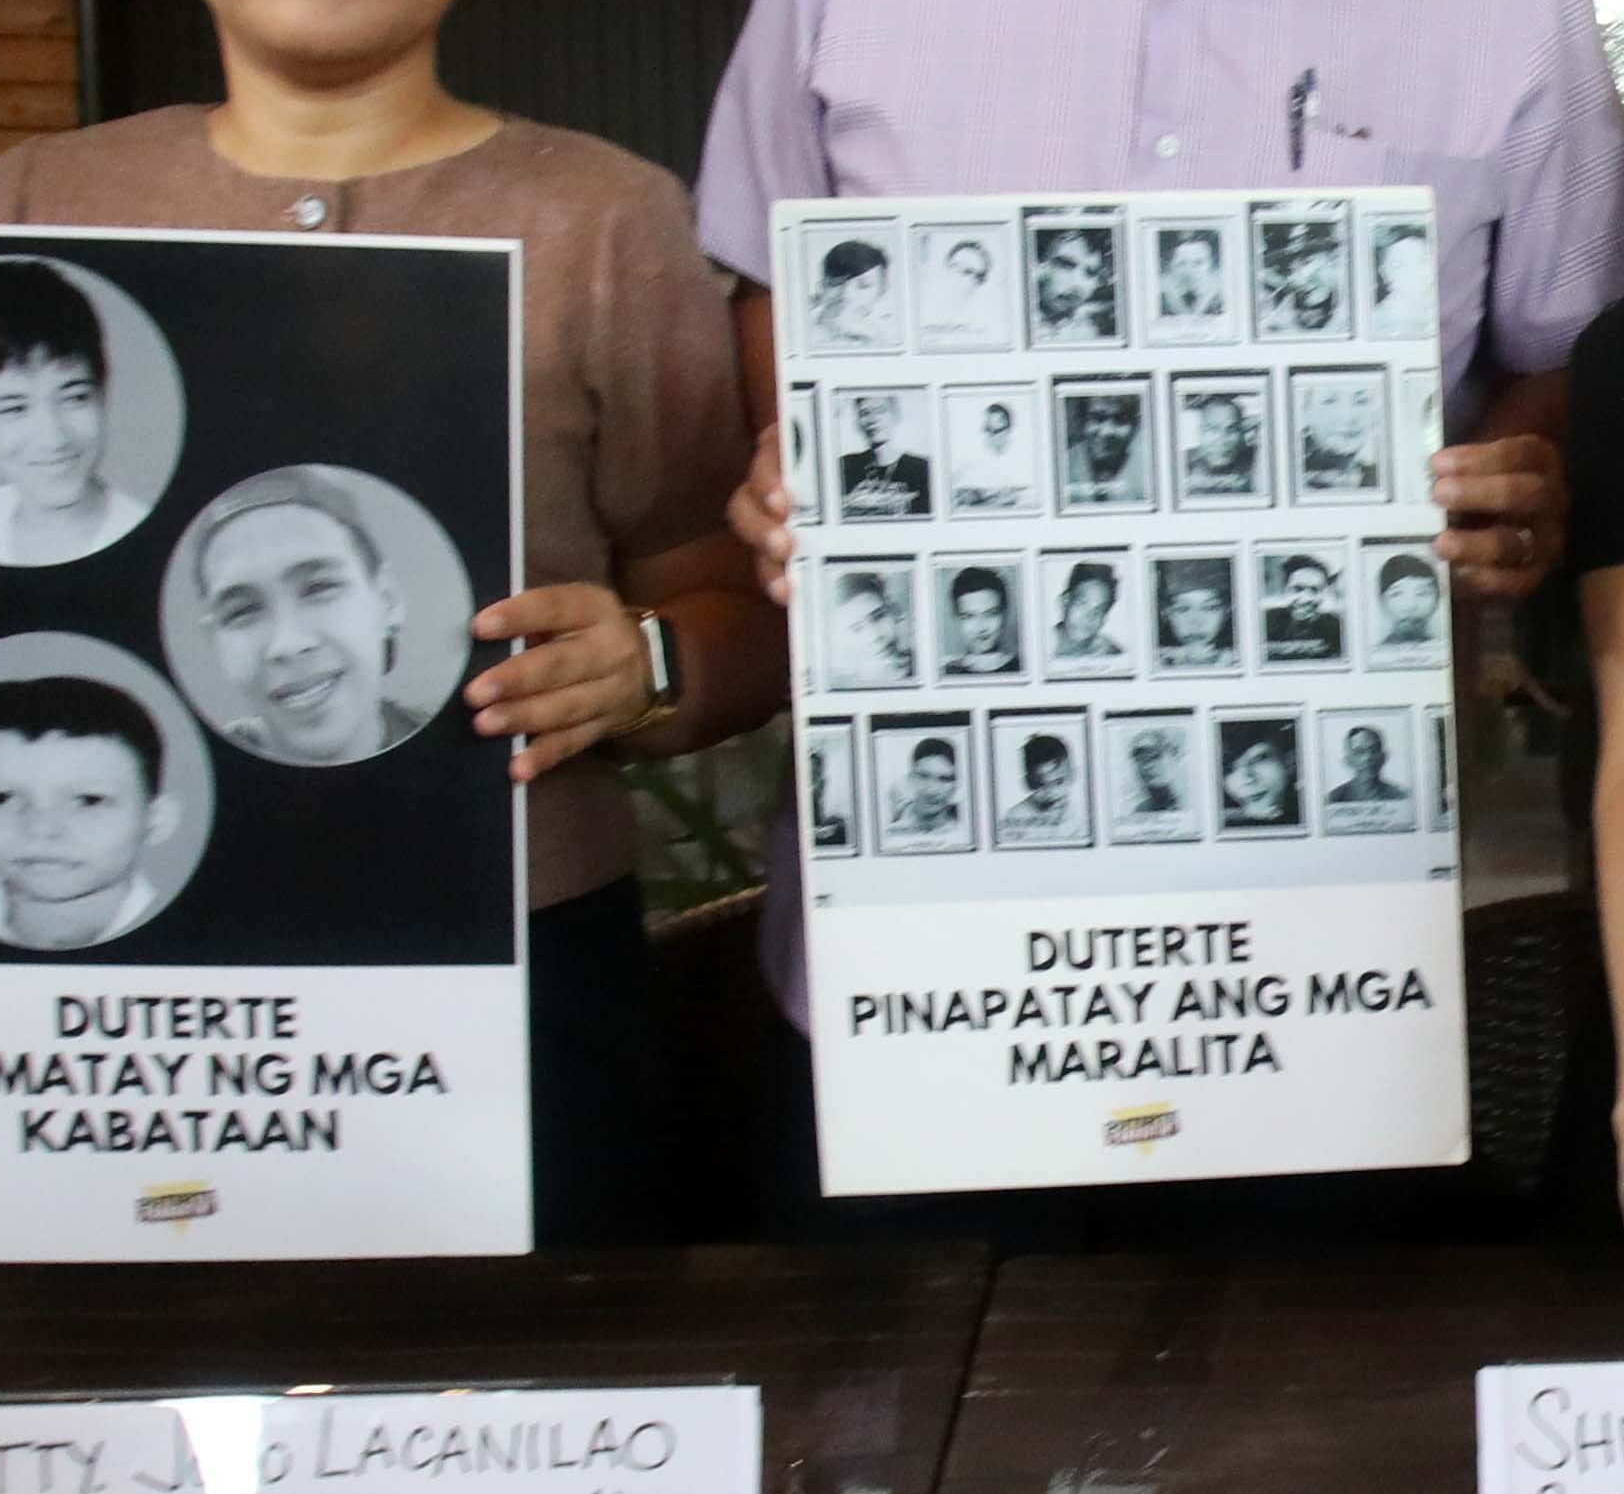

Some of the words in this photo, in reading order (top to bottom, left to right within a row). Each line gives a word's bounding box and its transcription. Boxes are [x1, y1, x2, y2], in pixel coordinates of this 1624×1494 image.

[1025, 920, 1254, 974] DUTERTE
[54, 993, 300, 1041] DUTERTE
[848, 979, 1159, 1038] PINAPATAY
[1171, 975, 1293, 1024] ANG
[1304, 967, 1437, 1018] MGA
[206, 1052, 293, 1097] NG
[308, 1051, 449, 1097] MGA
[1006, 1031, 1284, 1088] MARALITA
[18, 1108, 341, 1153] KABATAAN
[313, 1405, 678, 1480] LACANILAO
